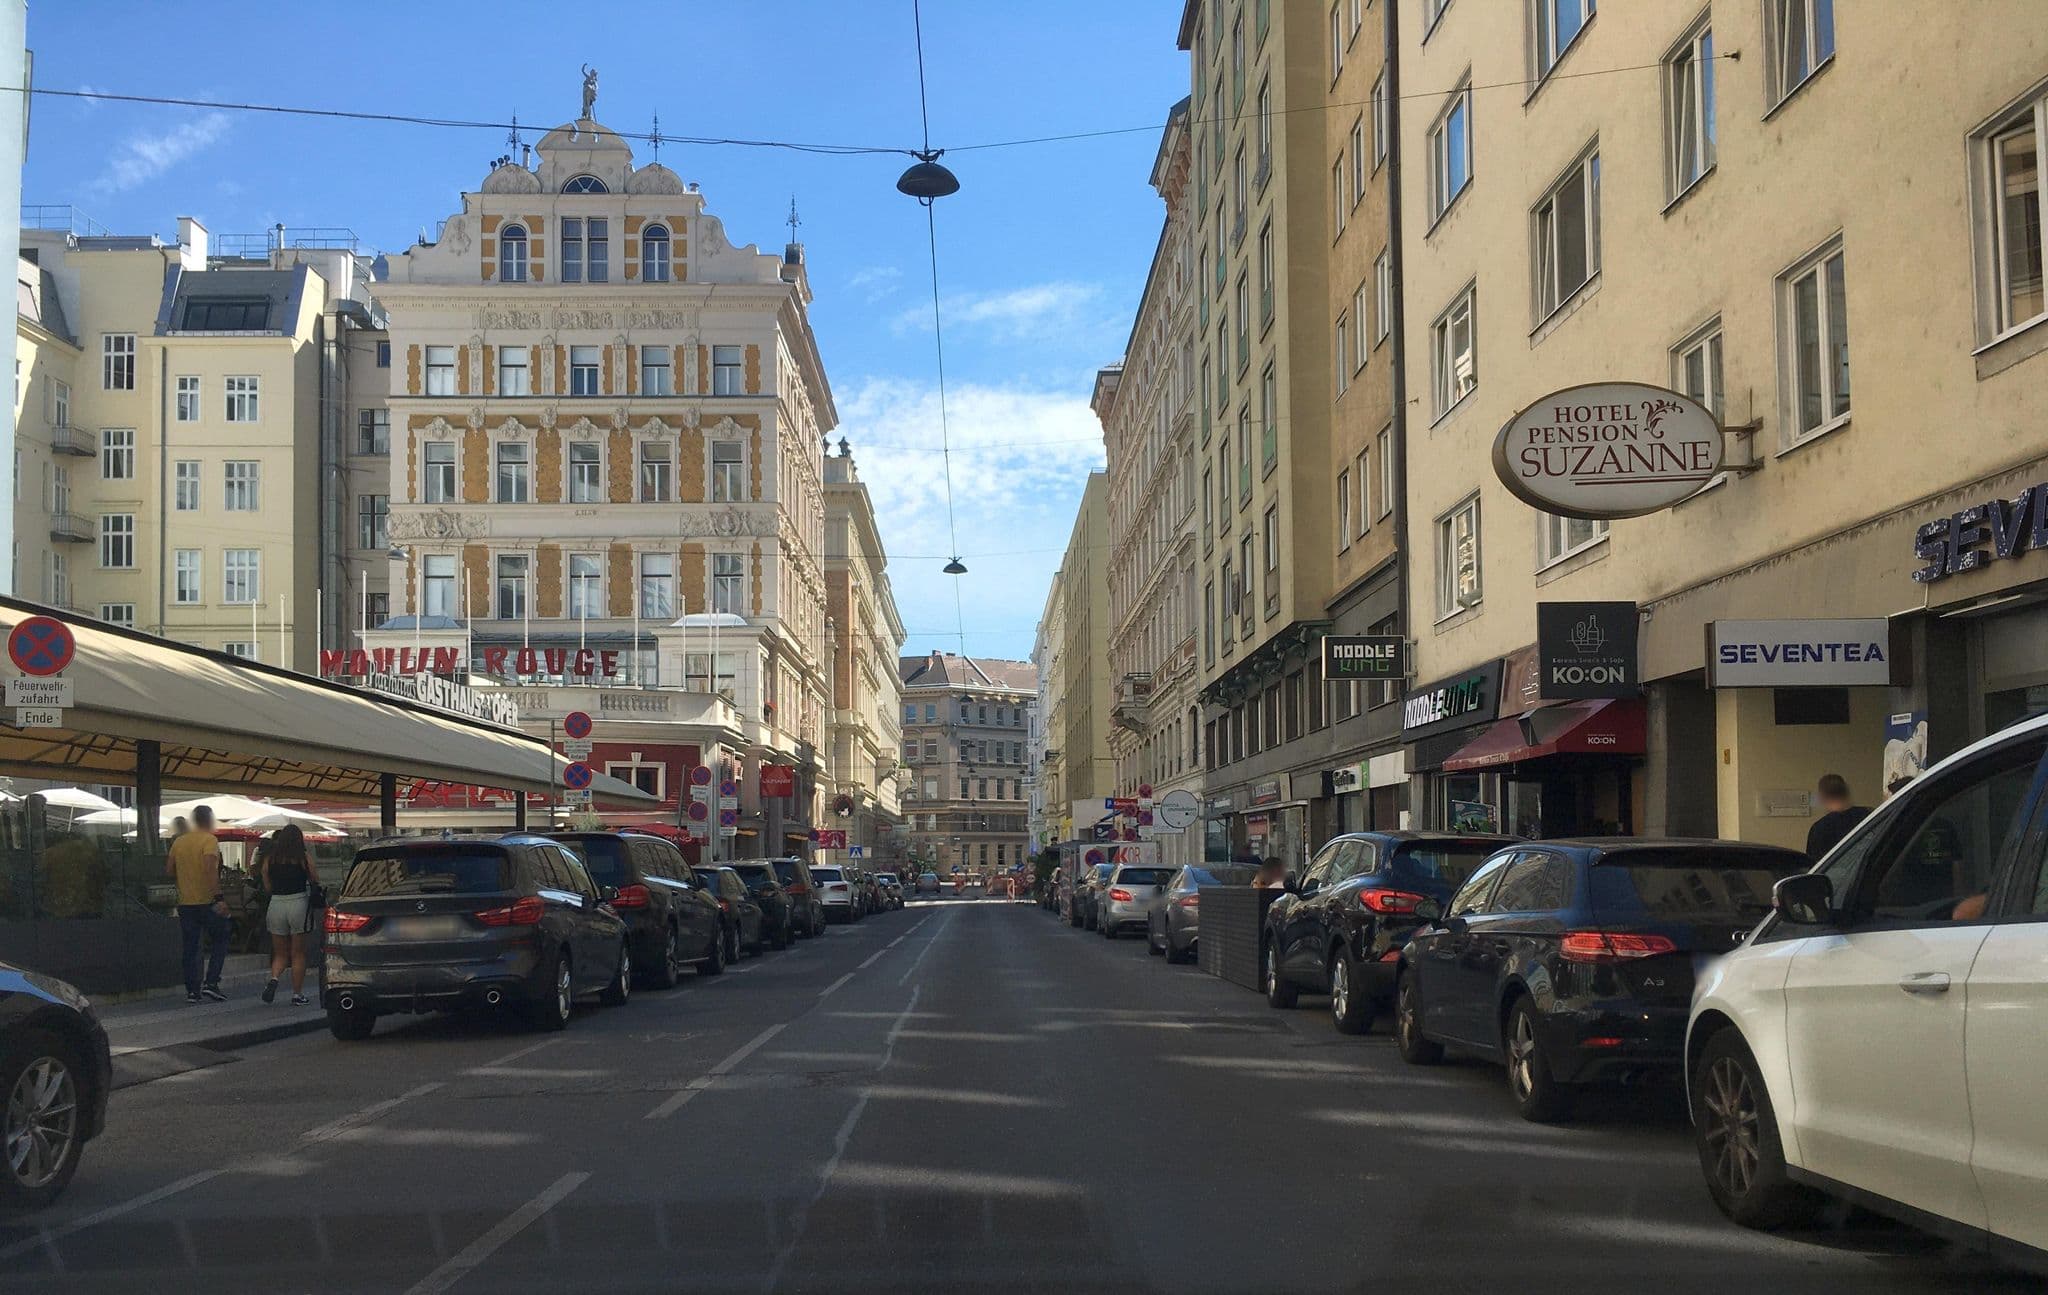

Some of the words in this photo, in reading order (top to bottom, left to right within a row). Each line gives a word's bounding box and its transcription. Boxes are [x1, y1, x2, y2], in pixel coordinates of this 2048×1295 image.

[1555, 405, 1637, 423] HOTEL
[1528, 424, 1638, 444] PENSION
[1520, 441, 1713, 478] SUZANNE
[1333, 644, 1395, 659] NOODLE
[1720, 642, 1886, 664] SEVENTEA
[320, 647, 459, 677] MOULIN
[483, 647, 619, 677] ROUGE
[1340, 659, 1390, 672] KING
[1552, 666, 1625, 684] KO:ON
[20, 692, 60, 705] zufahrt
[415, 671, 482, 718] GASTHAUS
[492, 694, 519, 727] OPER
[25, 711, 53, 724] Ende
[1588, 736, 1616, 745] KO:ON
[1643, 977, 1665, 986] A3
